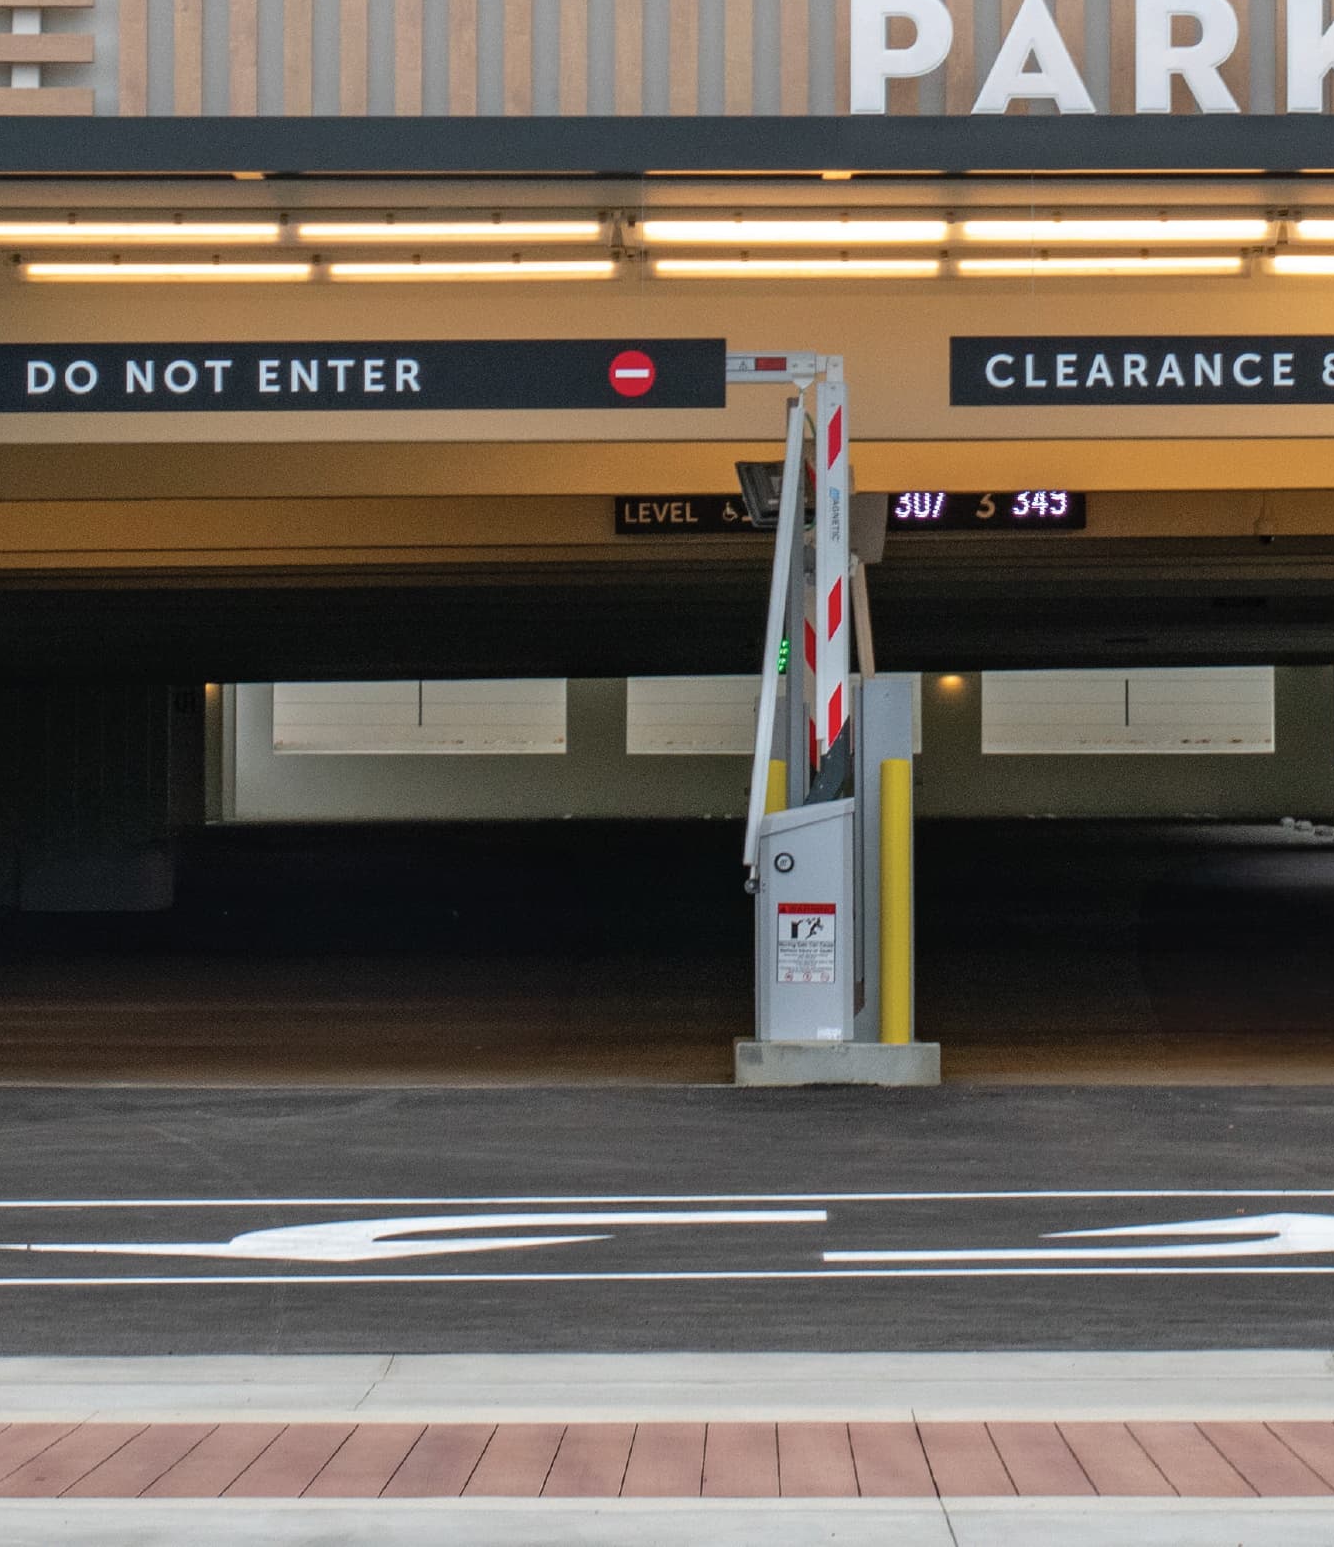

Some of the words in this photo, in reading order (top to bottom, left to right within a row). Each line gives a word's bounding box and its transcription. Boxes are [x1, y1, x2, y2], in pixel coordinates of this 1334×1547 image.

[27, 360, 98, 395] DO
[126, 360, 232, 394] NOT
[258, 359, 421, 393] ENTER
[984, 353, 1295, 388] CLEARANCE
[624, 502, 698, 523] LEVEL
